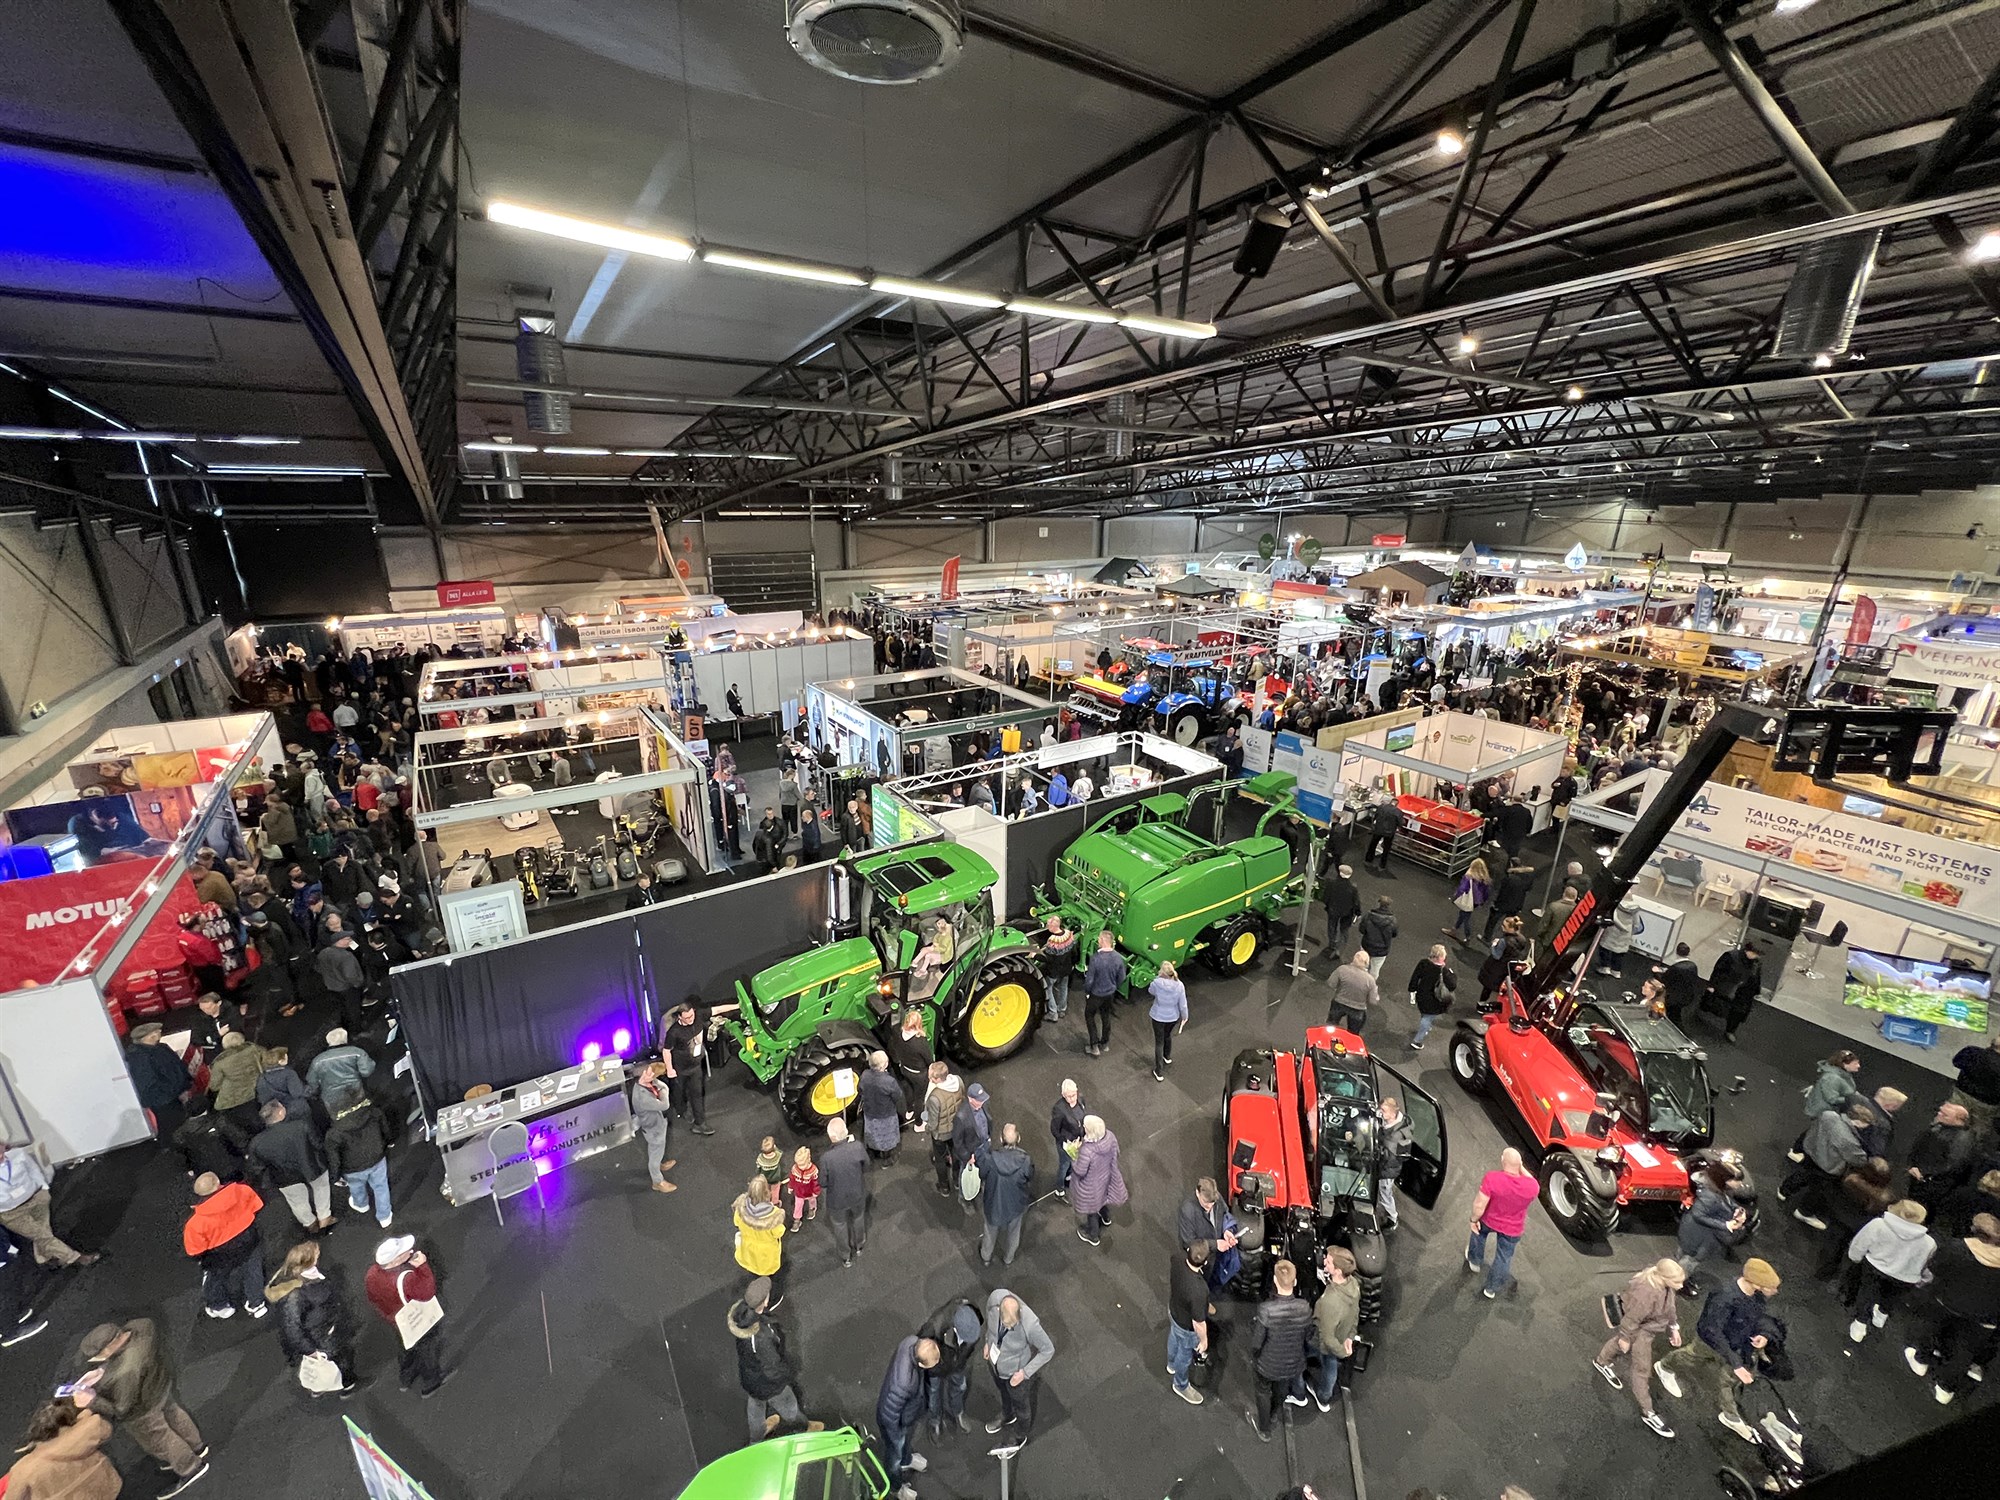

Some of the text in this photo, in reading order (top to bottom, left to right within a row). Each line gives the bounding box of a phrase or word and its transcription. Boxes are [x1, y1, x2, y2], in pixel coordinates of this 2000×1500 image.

[1933, 668, 1972, 678] VERKIN
[1744, 816, 1987, 886] THAT COMBAT BACTERIA AND FIGHT COSTS
[1746, 807, 1993, 877] TAILOR-MADE MIST SYSTEMS
[1552, 889, 1597, 956] MANITOU
[557, 1116, 579, 1131] ehf
[602, 1122, 617, 1135] HF
